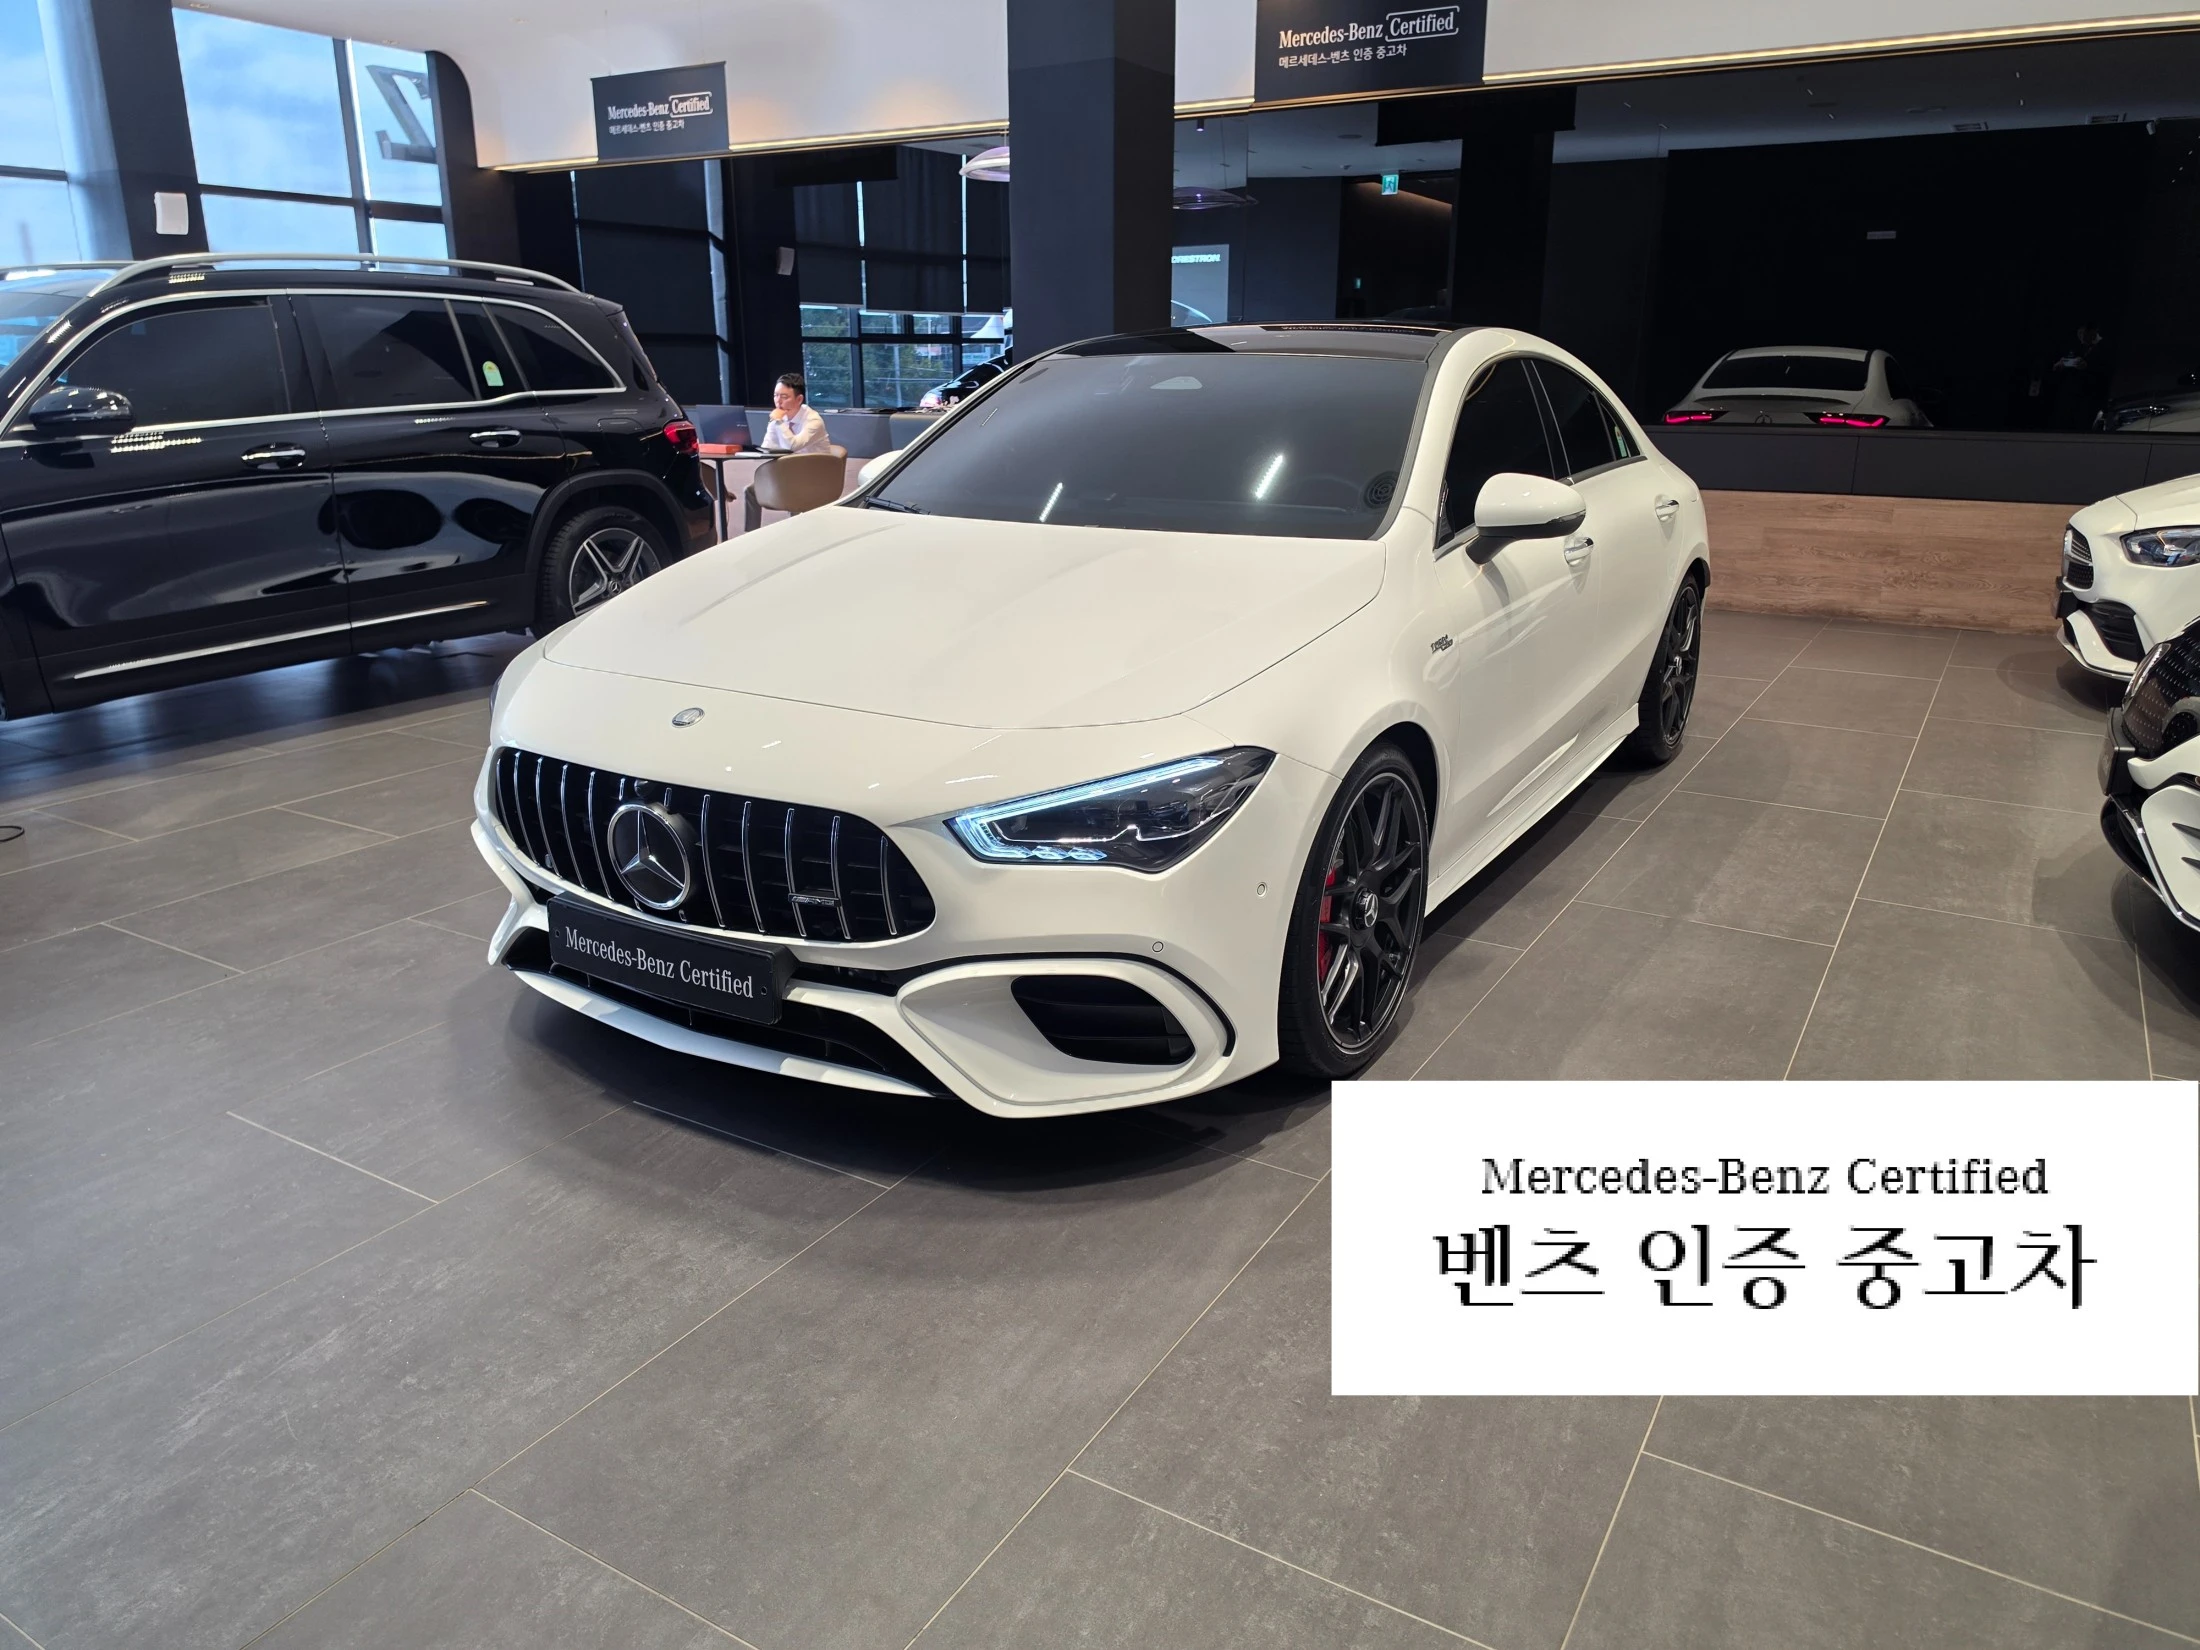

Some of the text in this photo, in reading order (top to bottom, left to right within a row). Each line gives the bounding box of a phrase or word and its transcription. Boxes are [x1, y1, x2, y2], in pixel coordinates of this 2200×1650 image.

[1278, 12, 1454, 49] Mercedes-Benz Certified
[1278, 43, 1408, 69] 메르세데스-벤츠 인증 중고차
[607, 96, 711, 121] Mercedes-Benz Certified
[565, 926, 754, 999] Mercedes-Benz Certified
